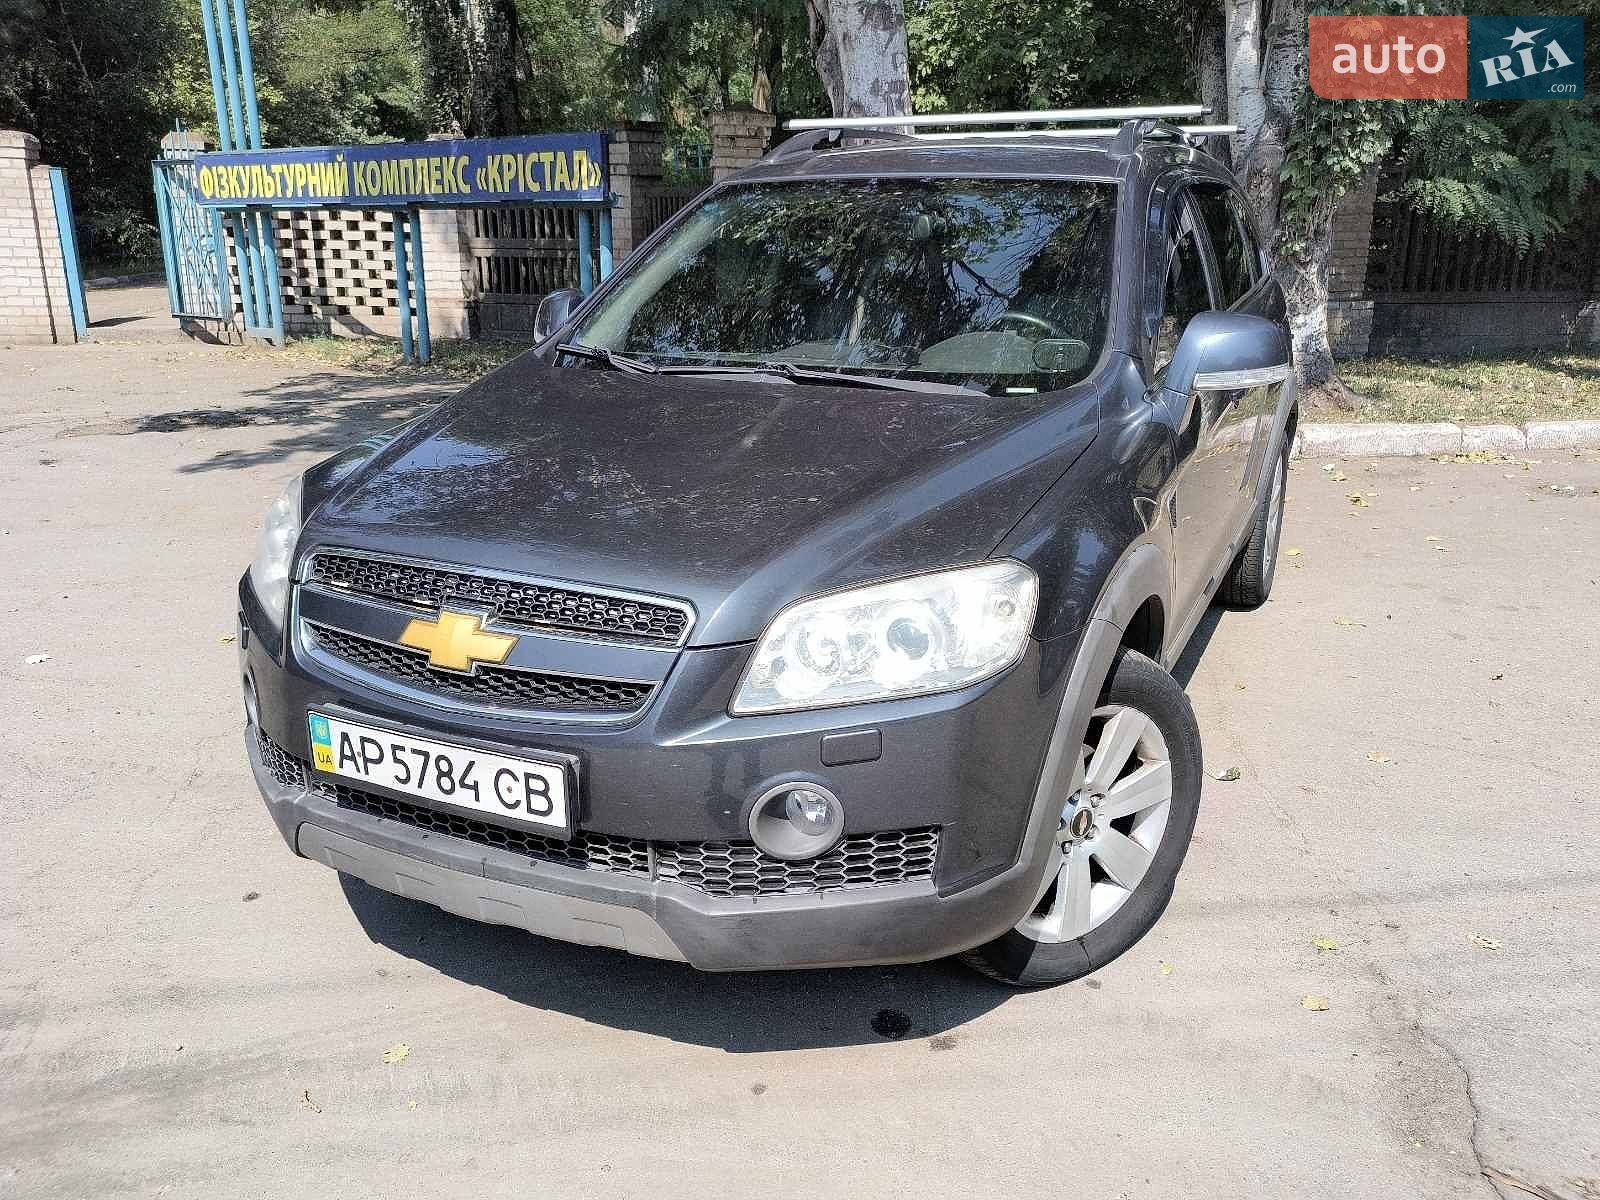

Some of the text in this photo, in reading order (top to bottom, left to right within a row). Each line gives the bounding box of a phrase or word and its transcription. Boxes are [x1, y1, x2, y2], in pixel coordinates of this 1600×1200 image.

[199, 150, 602, 199] ФІЗКУЛЬТУРНИЙ КОМПЛЕКС «КРІСТАЛ»
[318, 751, 333, 766] UA
[390, 744, 481, 803] 5784
